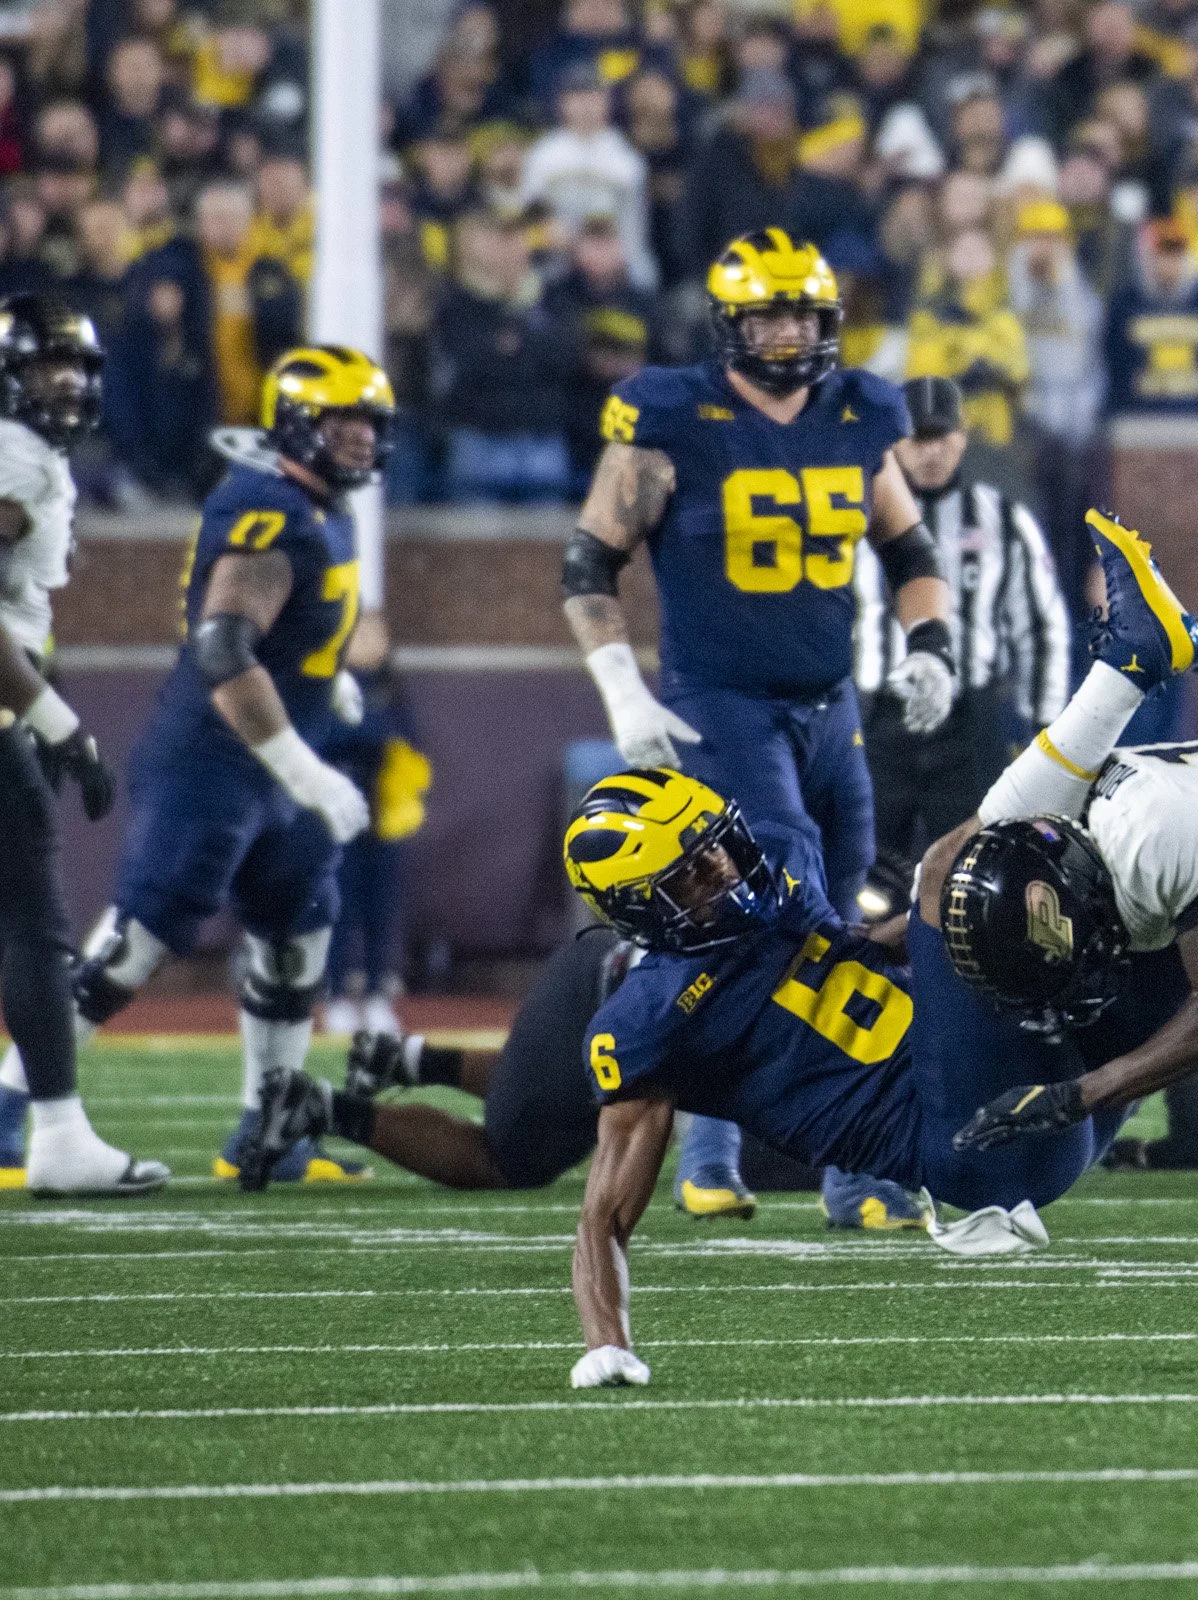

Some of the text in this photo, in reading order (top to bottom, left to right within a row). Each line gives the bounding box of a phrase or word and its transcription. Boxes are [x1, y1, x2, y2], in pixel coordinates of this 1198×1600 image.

[722, 465, 866, 592] 65
[590, 1033, 621, 1090] 6
[771, 933, 914, 1065] 6
